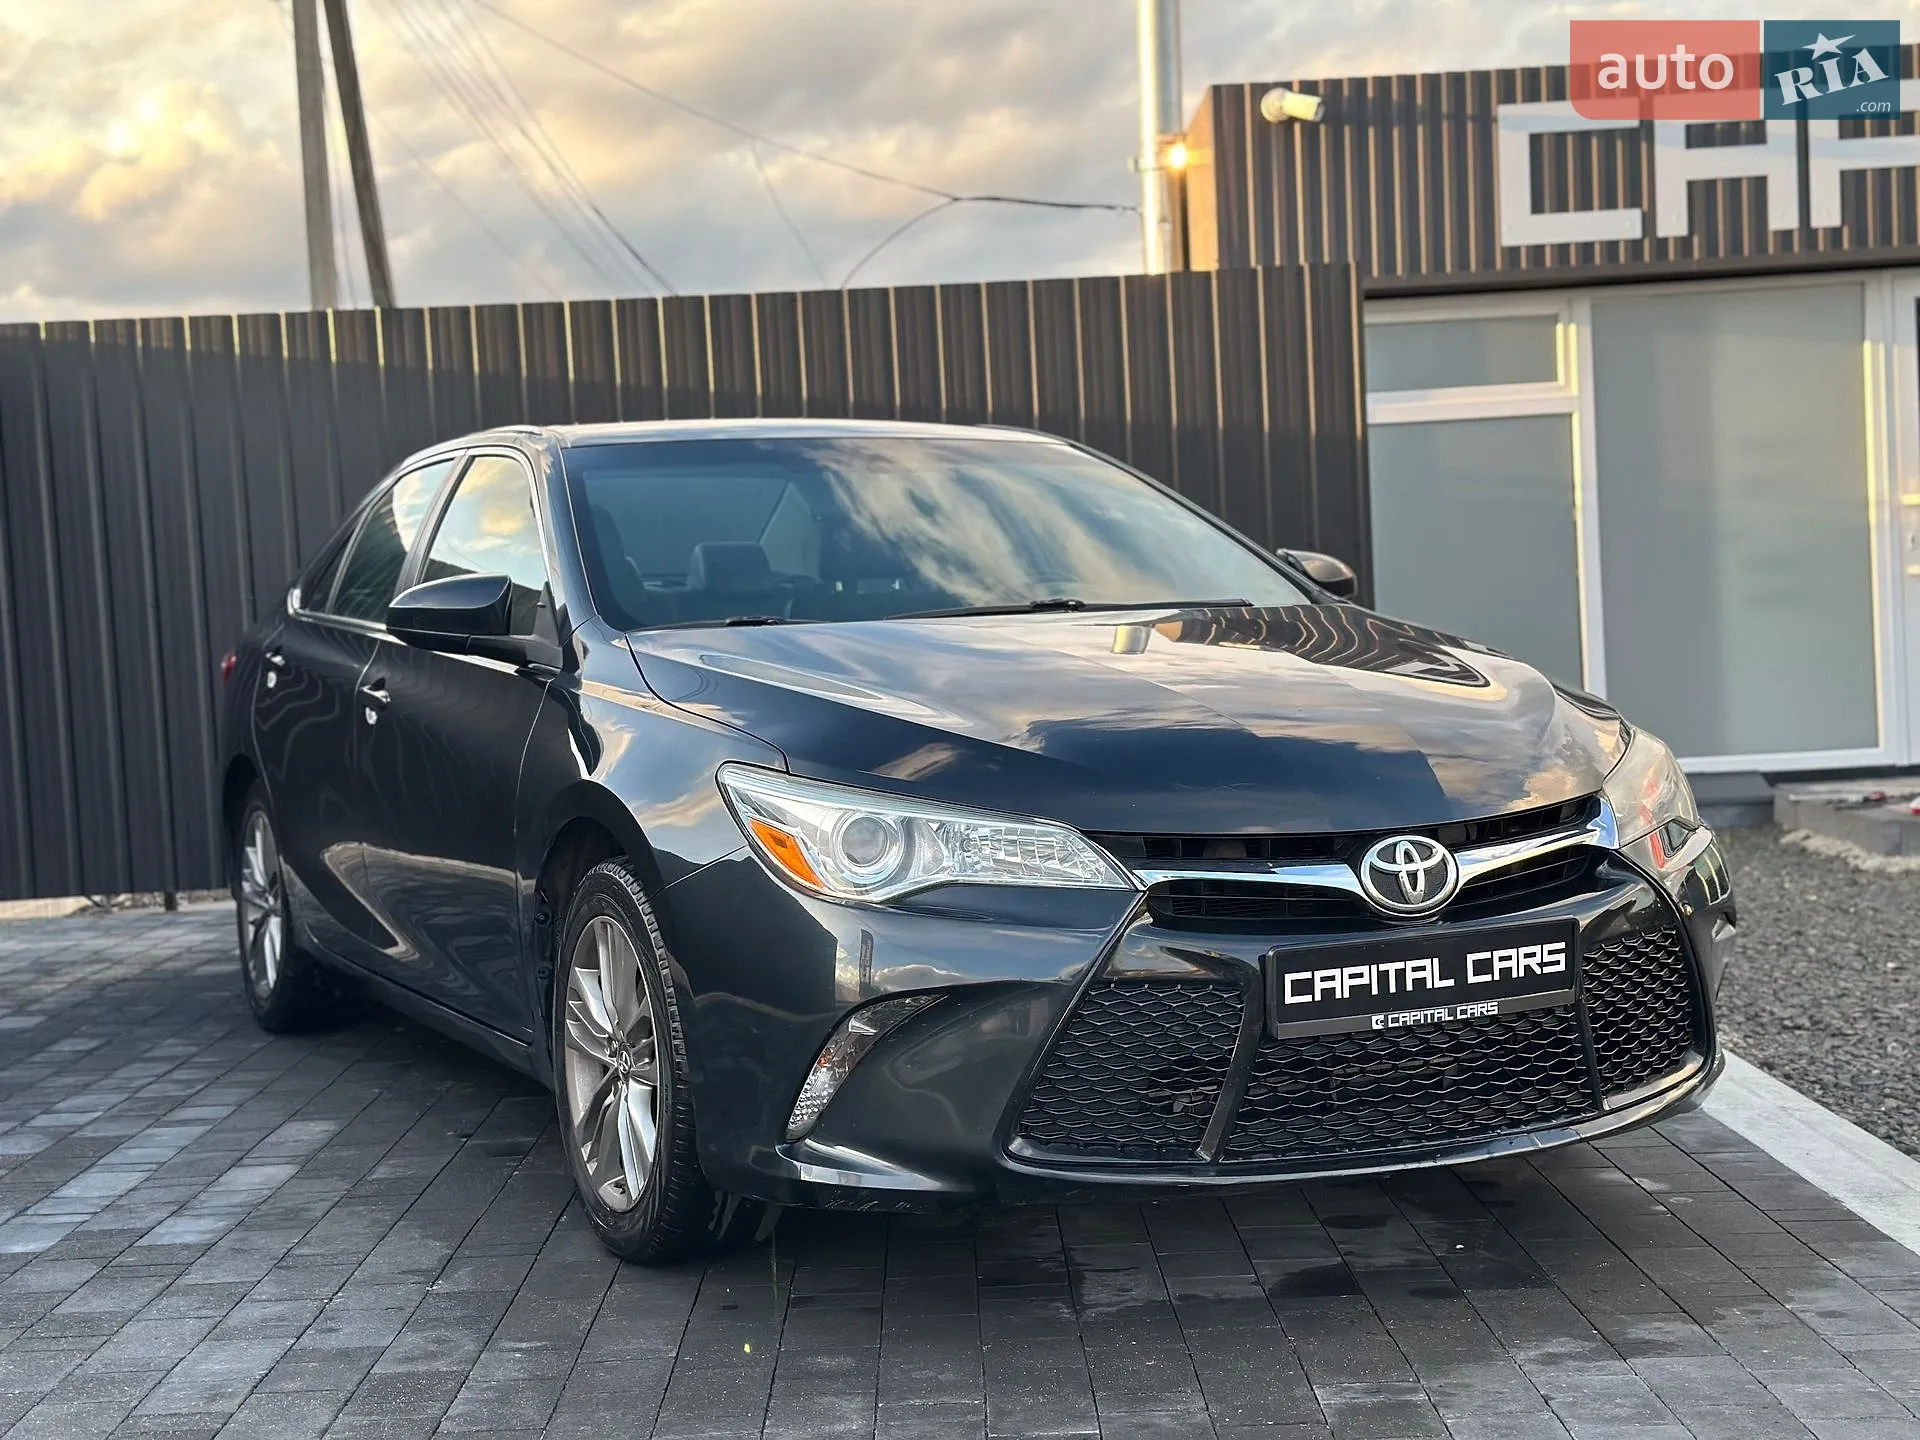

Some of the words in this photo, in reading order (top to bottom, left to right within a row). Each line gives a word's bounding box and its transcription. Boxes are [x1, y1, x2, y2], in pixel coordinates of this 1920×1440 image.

[1284, 957, 1455, 1005] CAPITAL
[1466, 941, 1566, 985] CARS
[1387, 1007, 1454, 1028] CAPITAL
[1456, 1001, 1499, 1020] CARS
